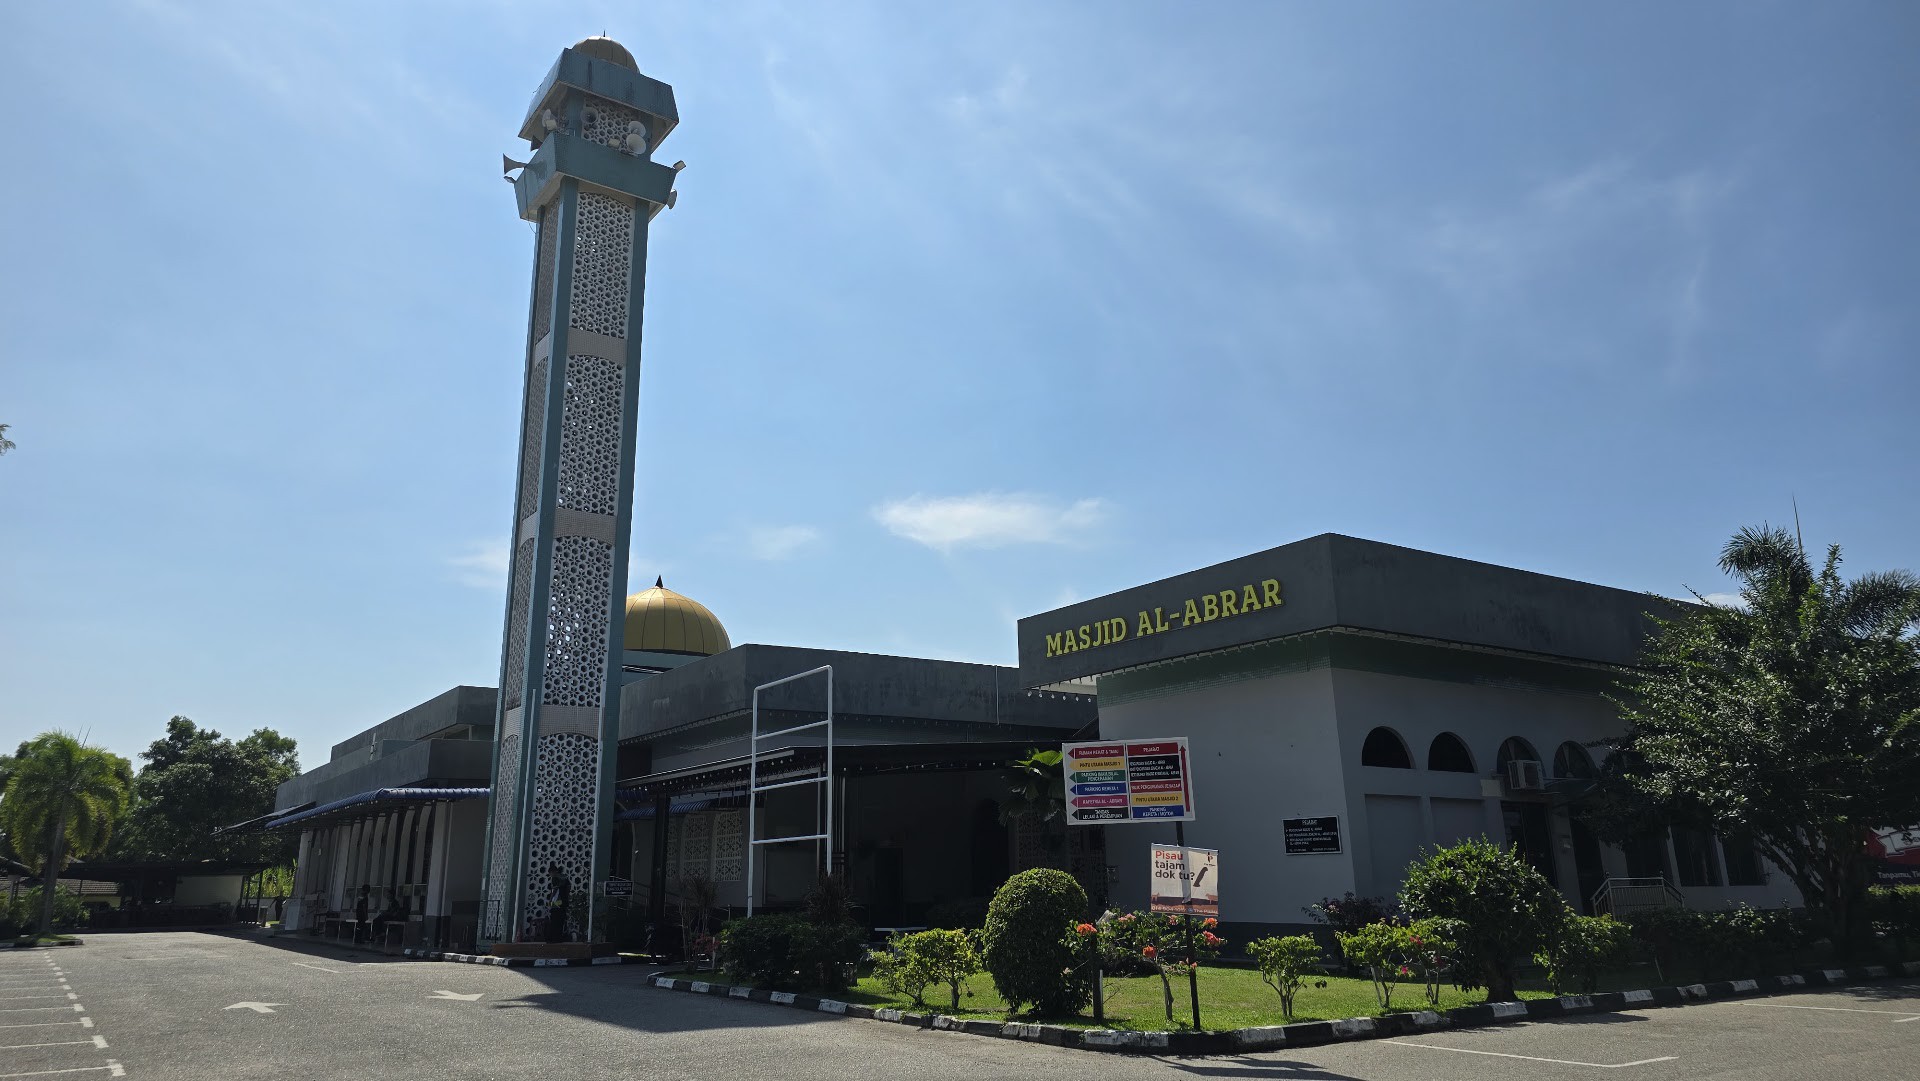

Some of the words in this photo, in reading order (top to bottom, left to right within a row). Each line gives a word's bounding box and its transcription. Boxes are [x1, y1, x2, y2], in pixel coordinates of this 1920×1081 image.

[1046, 618, 1127, 658] MASJID
[1137, 579, 1282, 636] AL-ABRAR
[1155, 850, 1183, 860] Pisau
[1155, 860, 1184, 870] tajam
[1155, 870, 1175, 879] dok
[1179, 872, 1195, 880] tu?
